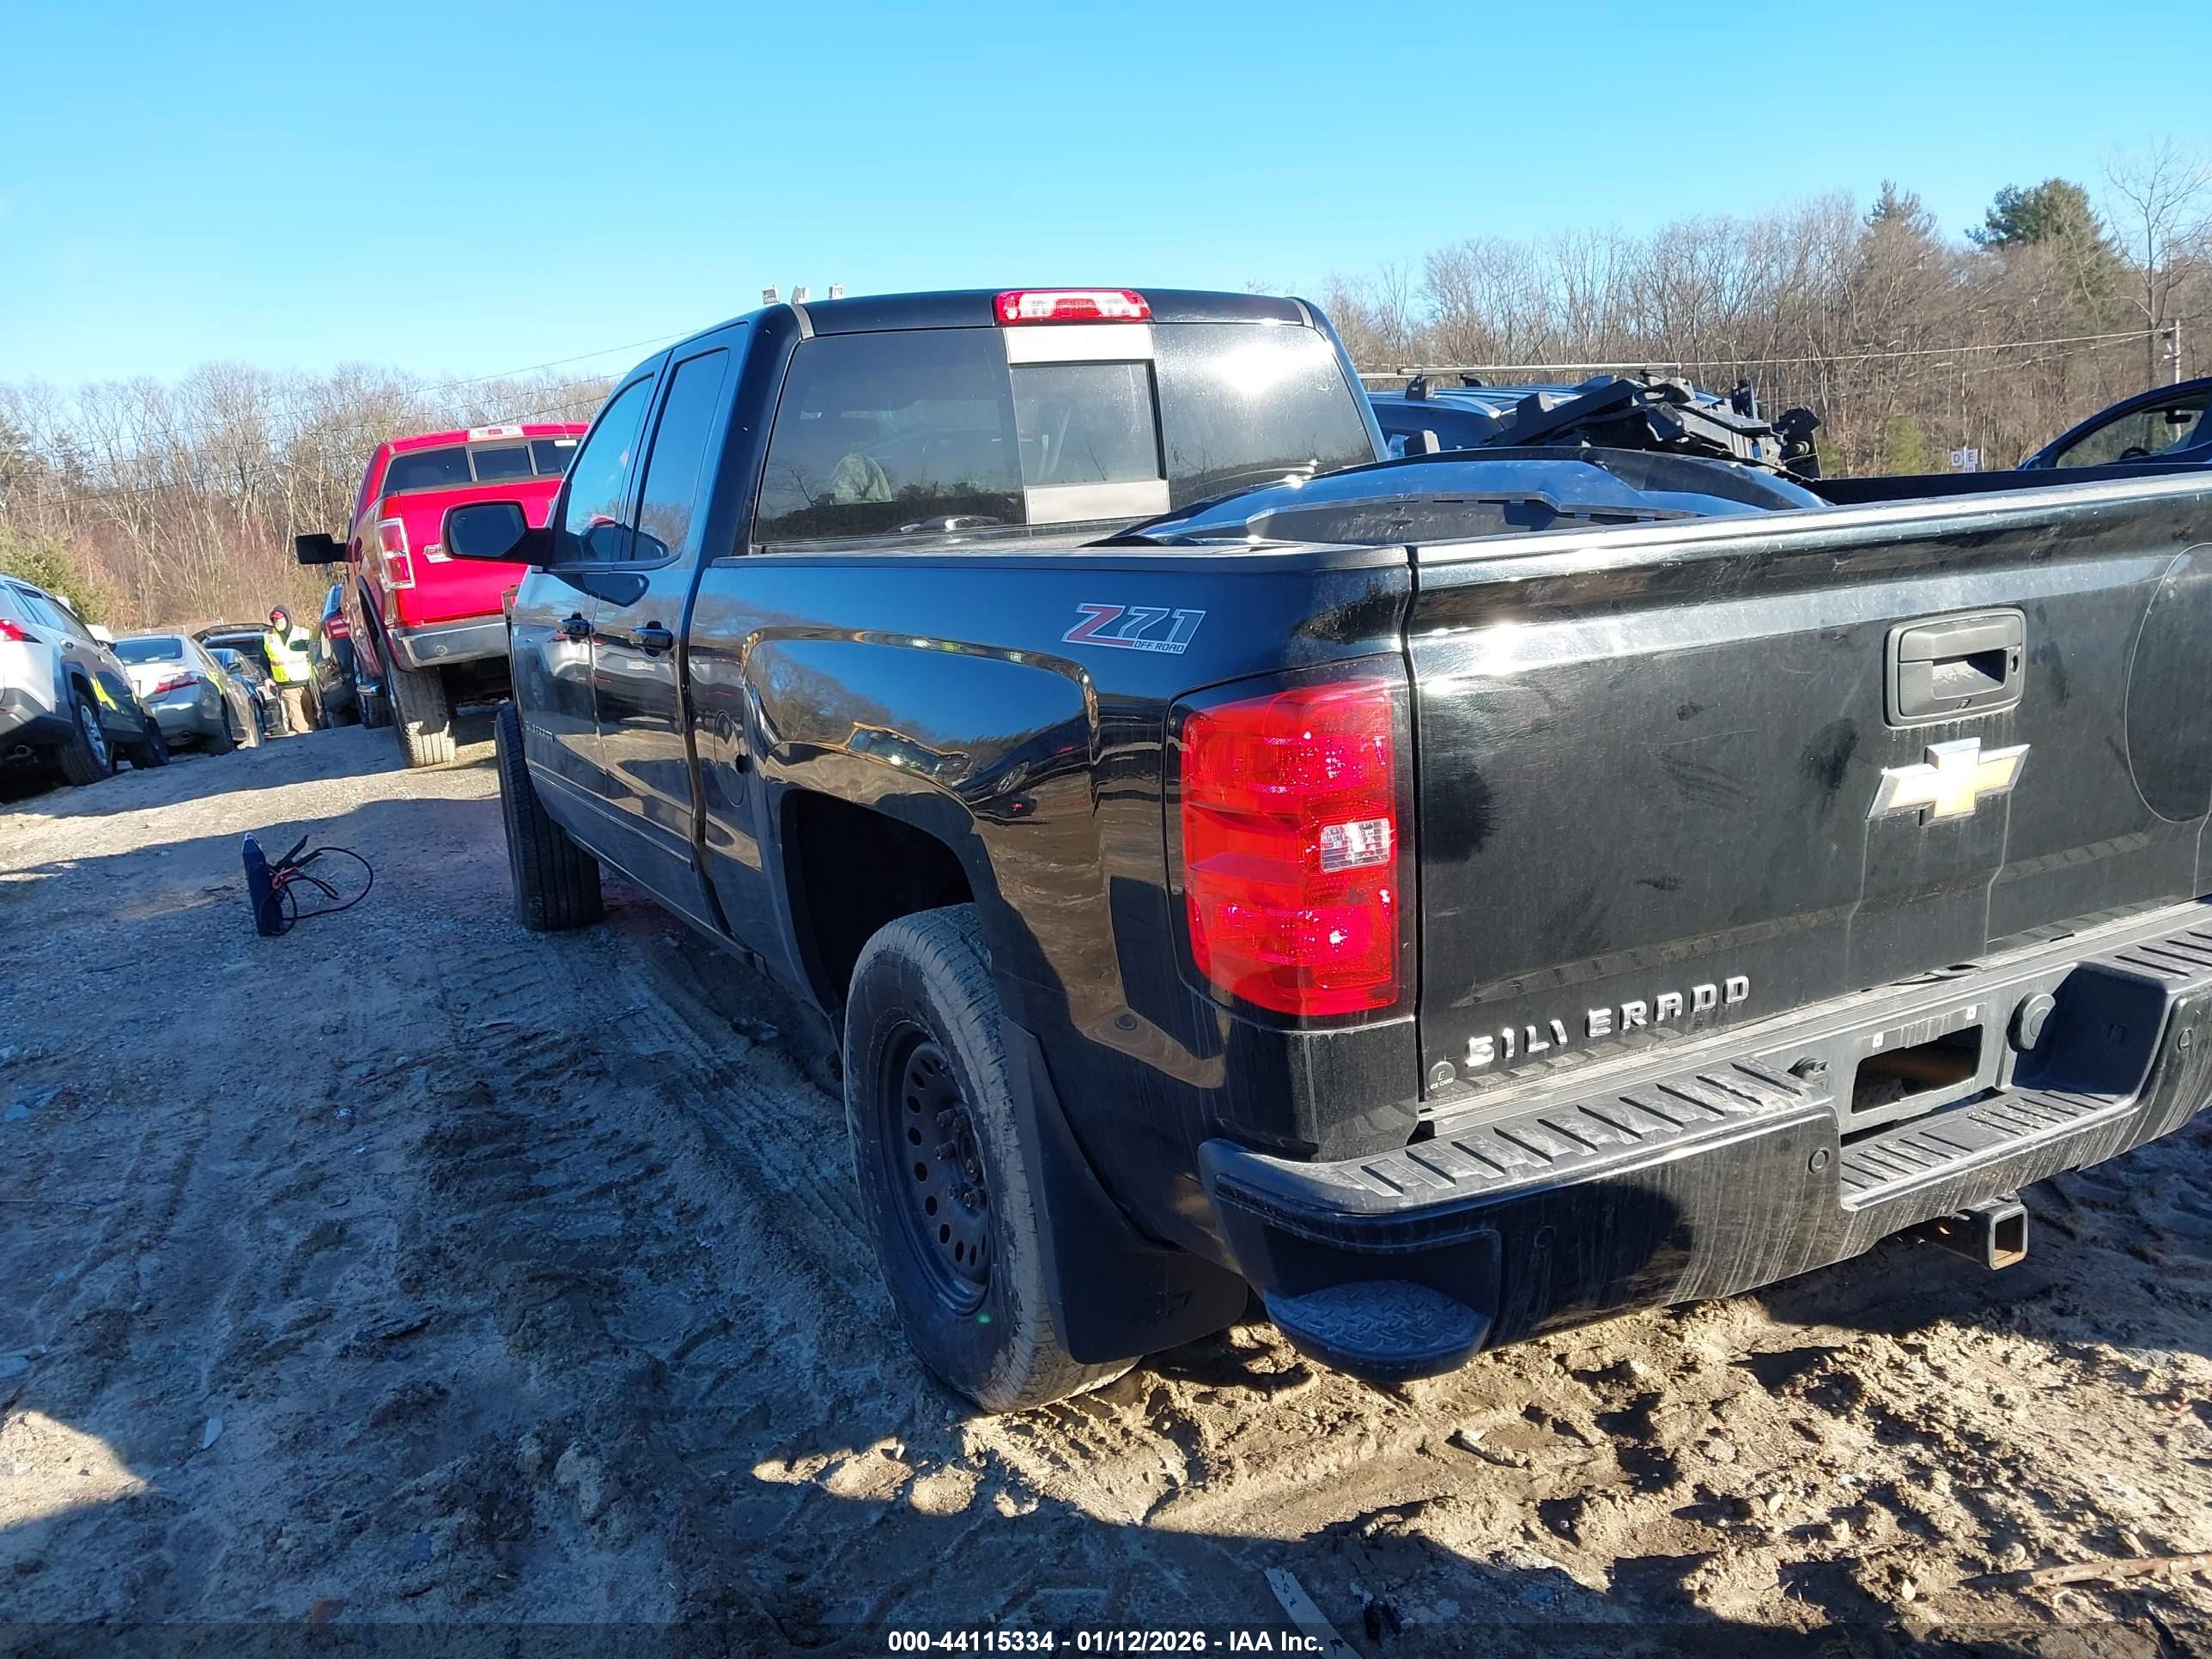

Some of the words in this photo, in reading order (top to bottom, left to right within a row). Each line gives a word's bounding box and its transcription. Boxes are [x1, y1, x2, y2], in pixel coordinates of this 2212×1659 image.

[1954, 453, 1960, 464] D
[1968, 452, 1974, 462] E
[1061, 603, 1206, 651] Z71
[1134, 640, 1154, 649] OFF
[1154, 643, 1185, 653] ROAD
